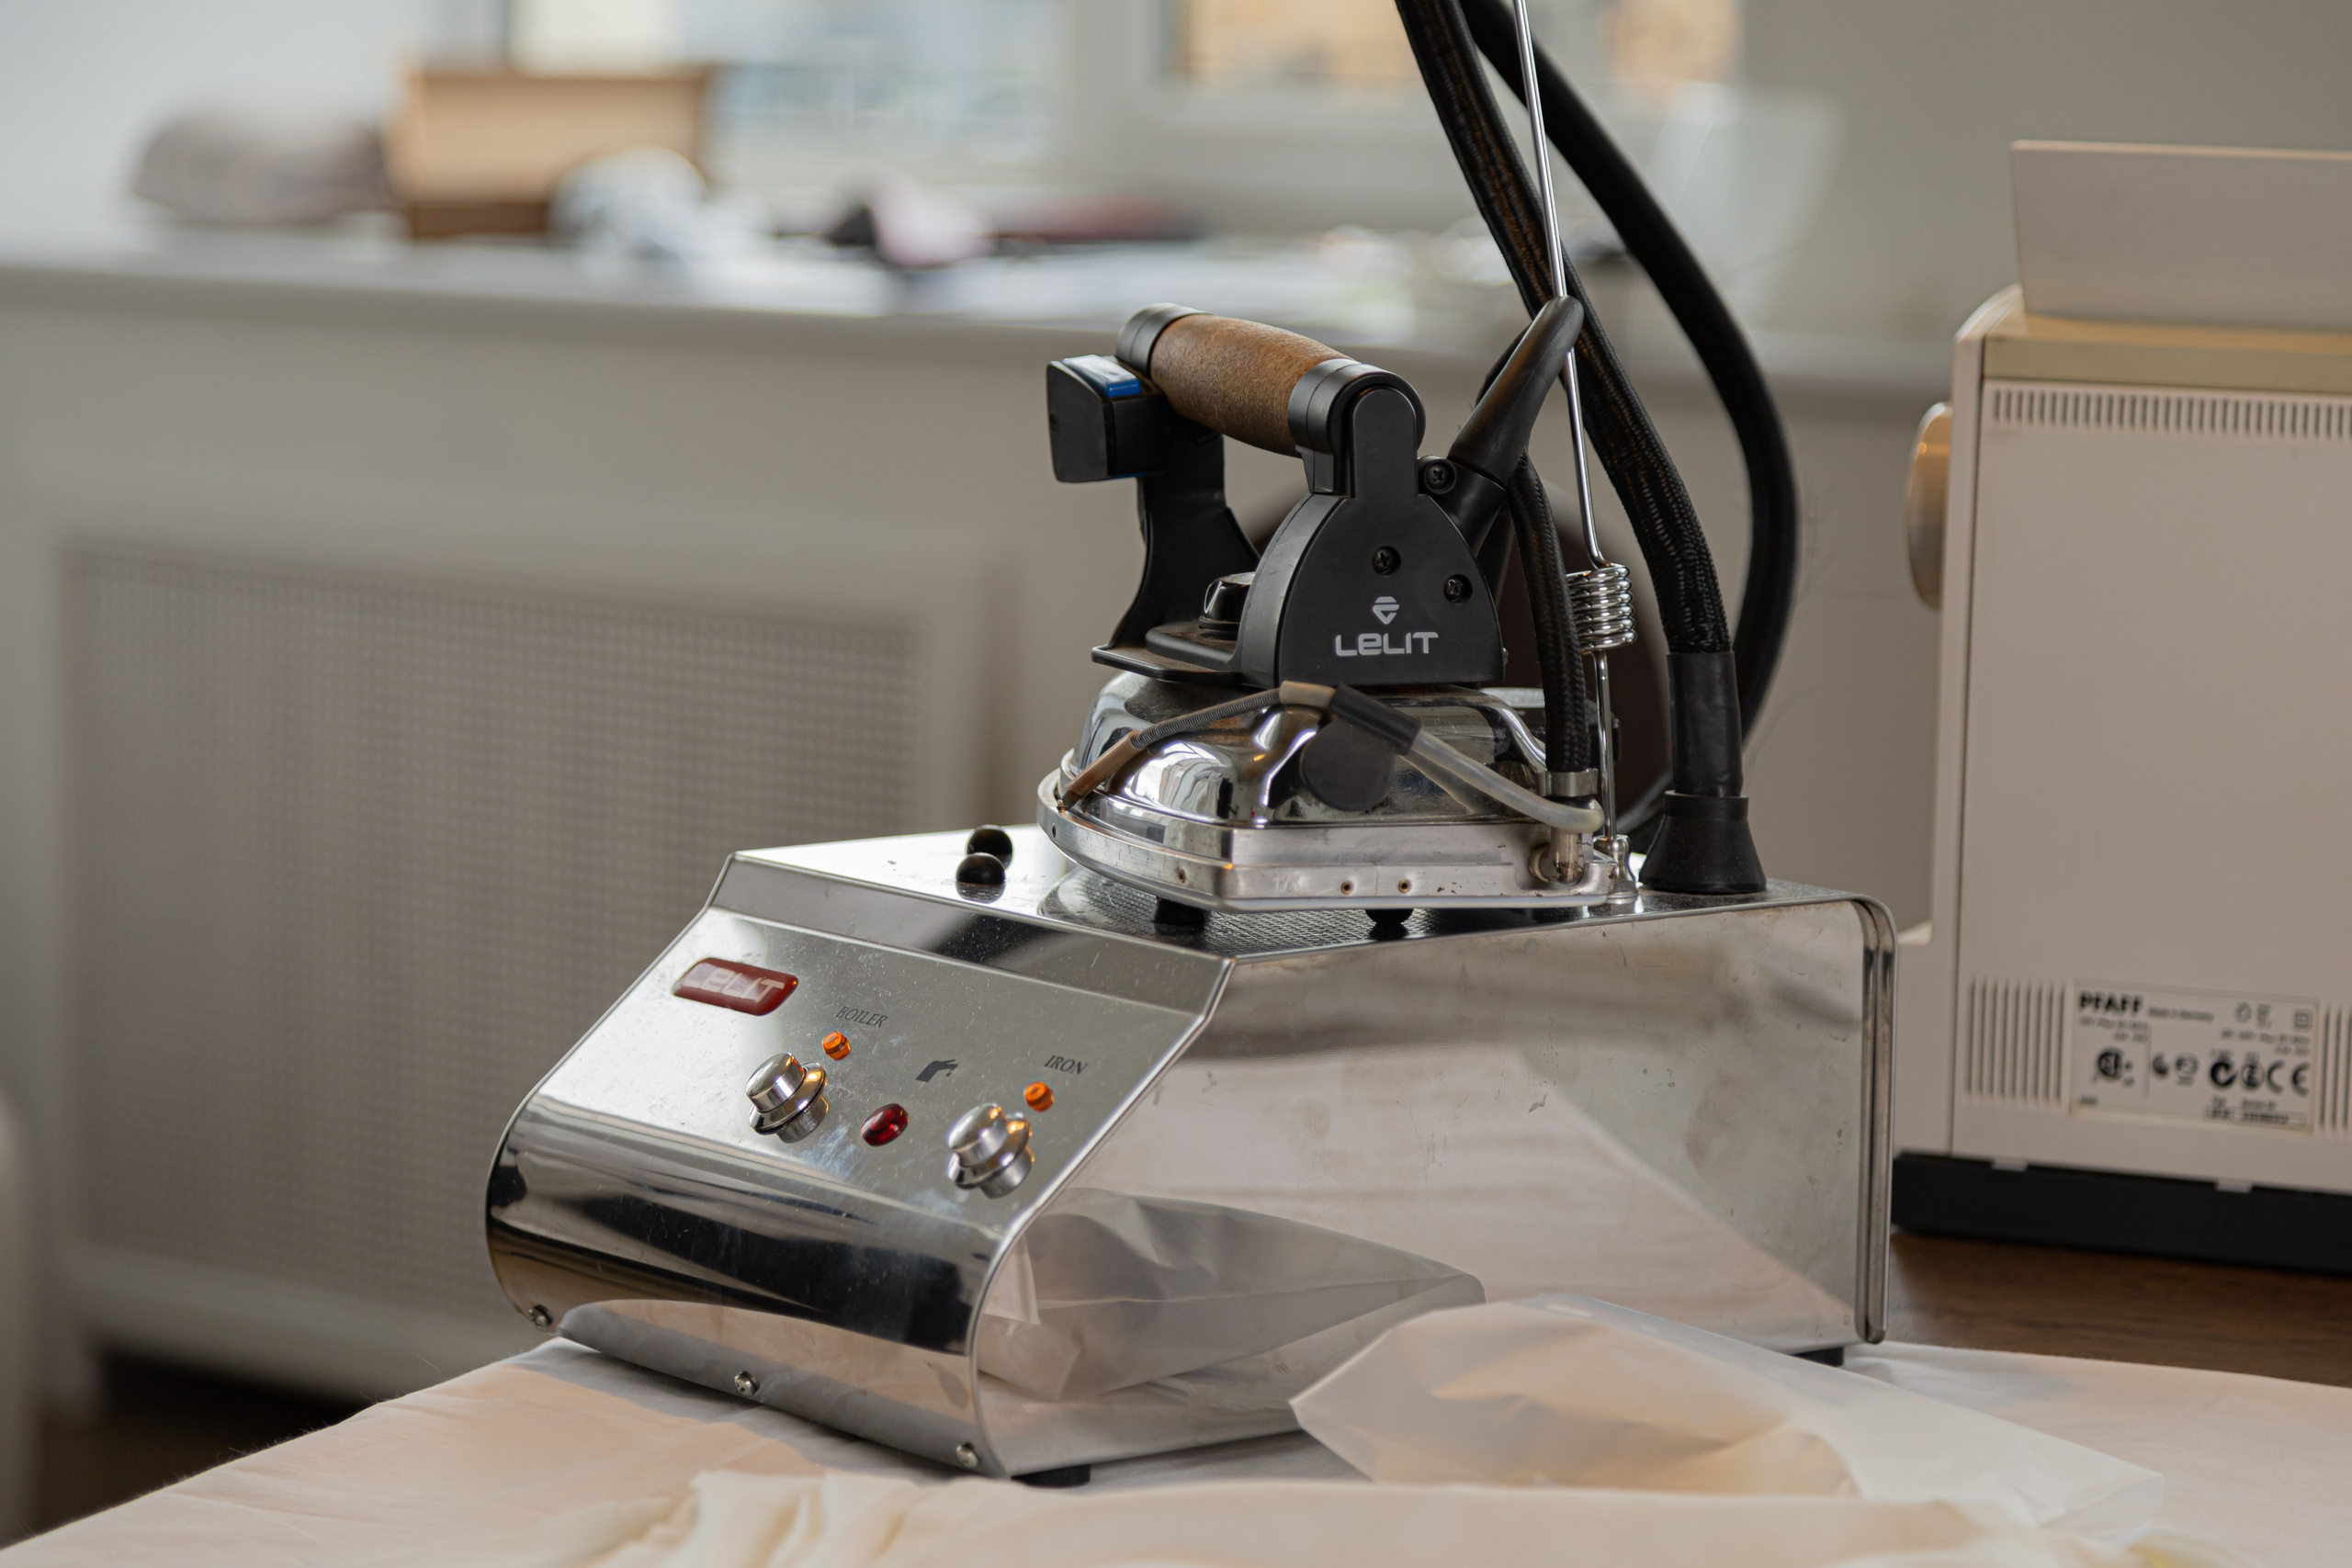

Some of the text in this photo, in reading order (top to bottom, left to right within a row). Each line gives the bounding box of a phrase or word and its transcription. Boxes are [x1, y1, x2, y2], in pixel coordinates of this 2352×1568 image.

[2079, 991, 2144, 1014] PFAFF
[835, 1006, 888, 1027] BOILER
[1044, 1055, 1088, 1075] IRON
